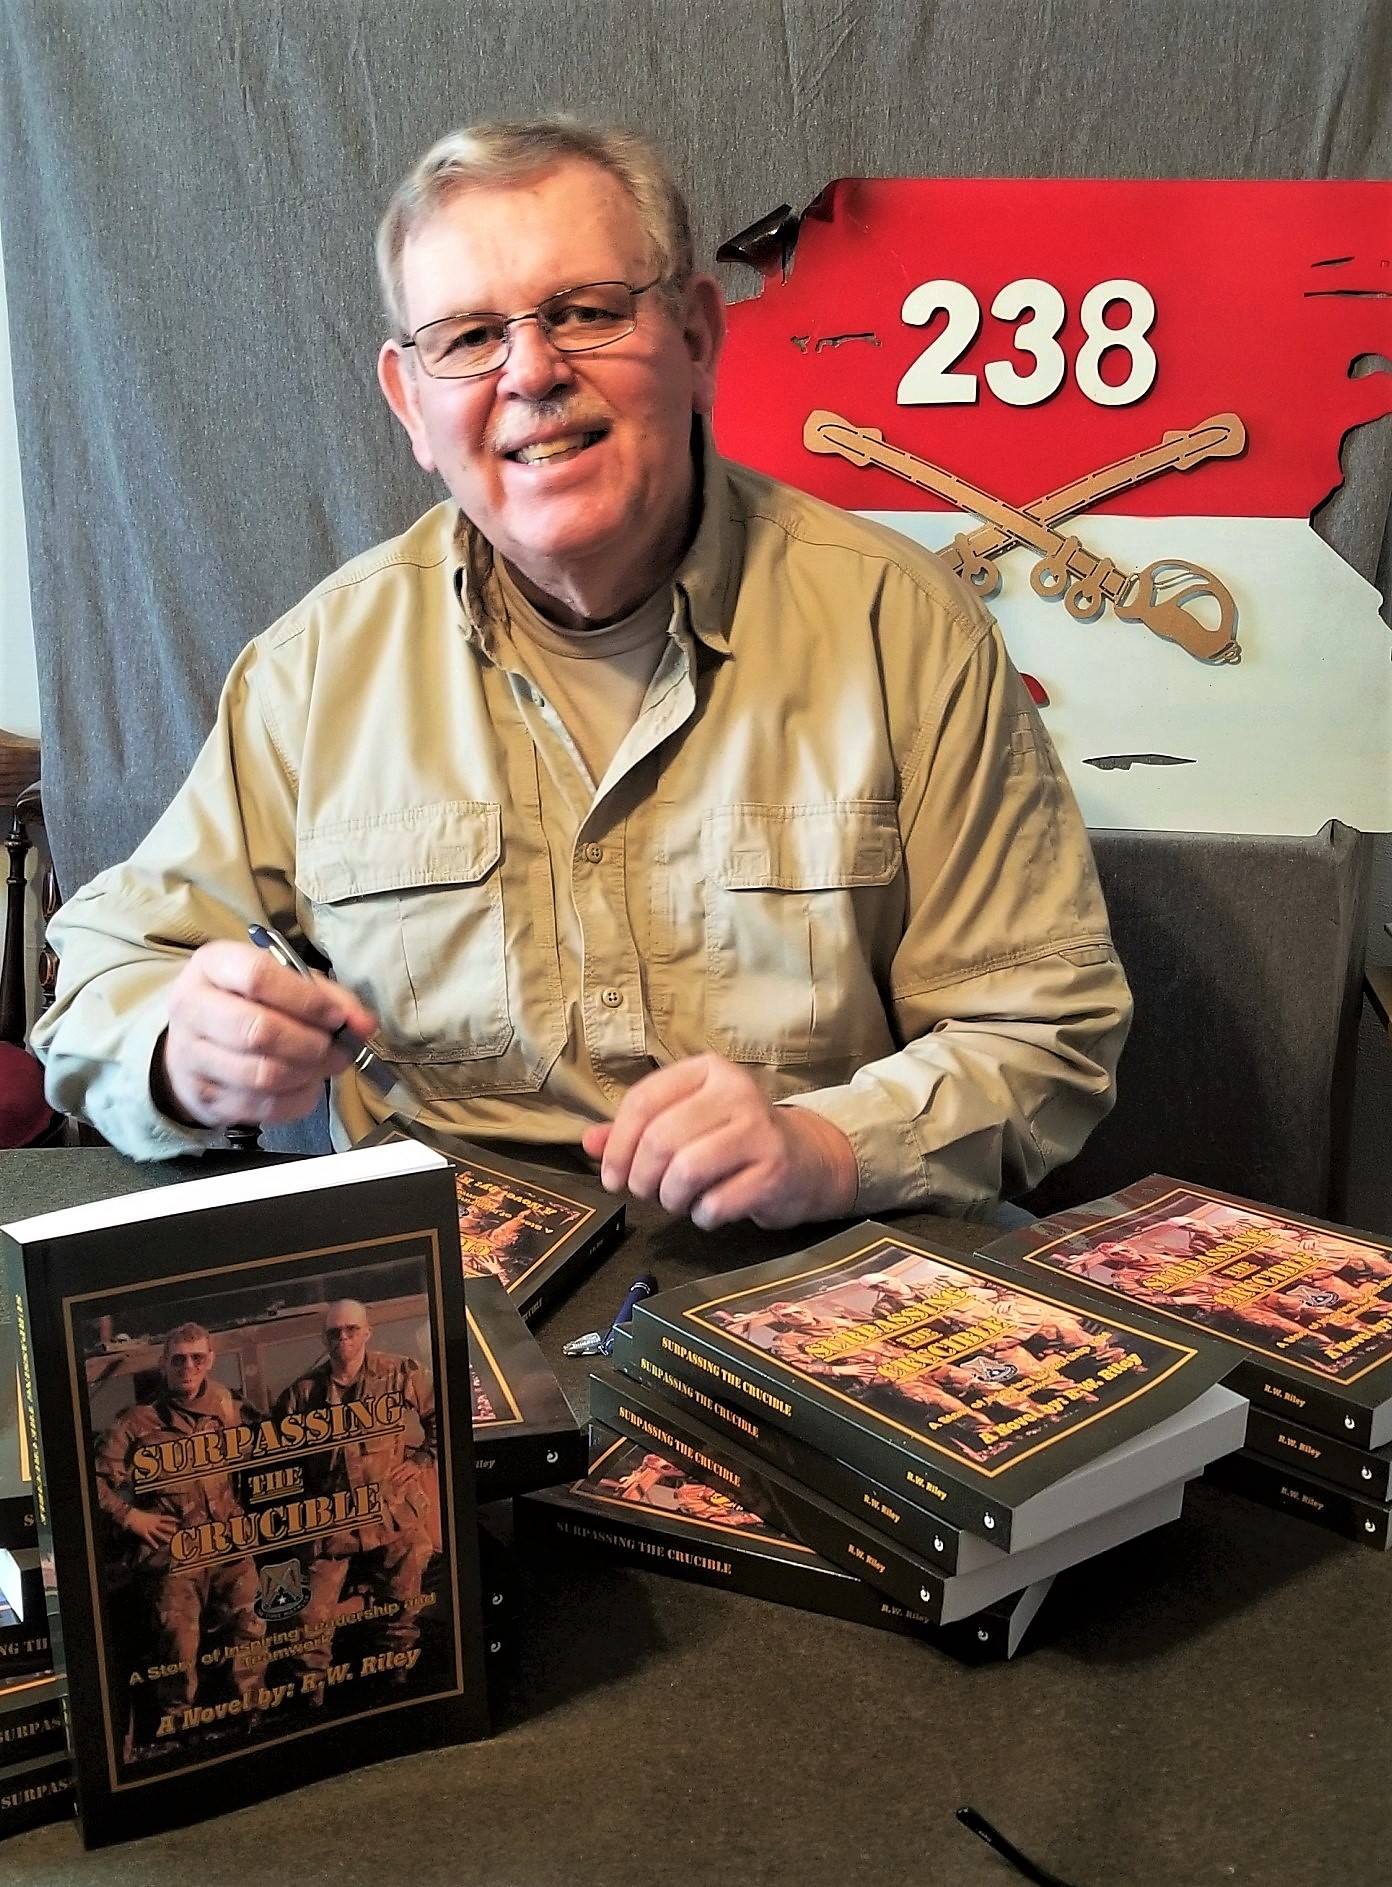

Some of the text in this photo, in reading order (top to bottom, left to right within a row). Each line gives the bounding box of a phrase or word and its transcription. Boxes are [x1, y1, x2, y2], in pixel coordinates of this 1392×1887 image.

[896, 278, 1157, 406] 238
[1142, 1227, 1272, 1291] SURPASSING
[804, 1286, 967, 1358] SURPASSING
[876, 1316, 1009, 1381] CRUCIBLE
[640, 1358, 695, 1399] SURPASSING
[694, 1388, 714, 1410] THE
[714, 1402, 760, 1439] CRUCIBLE
[660, 1336, 721, 1378] SURPASSING
[720, 1367, 743, 1389] THE
[742, 1380, 793, 1417] CRUCIBLE
[133, 1391, 404, 1484] SURPASSING
[618, 1405, 674, 1447] SURPASSING
[674, 1438, 695, 1459] THE
[694, 1451, 742, 1488] CRUCIBLE
[249, 1466, 305, 1497] THE
[169, 1482, 381, 1562] CRUCIBLE
[638, 1540, 665, 1558] THE
[666, 1547, 733, 1576] CRUCIBLE
[156, 1648, 422, 1738] A Novel by: R.W. Riley
